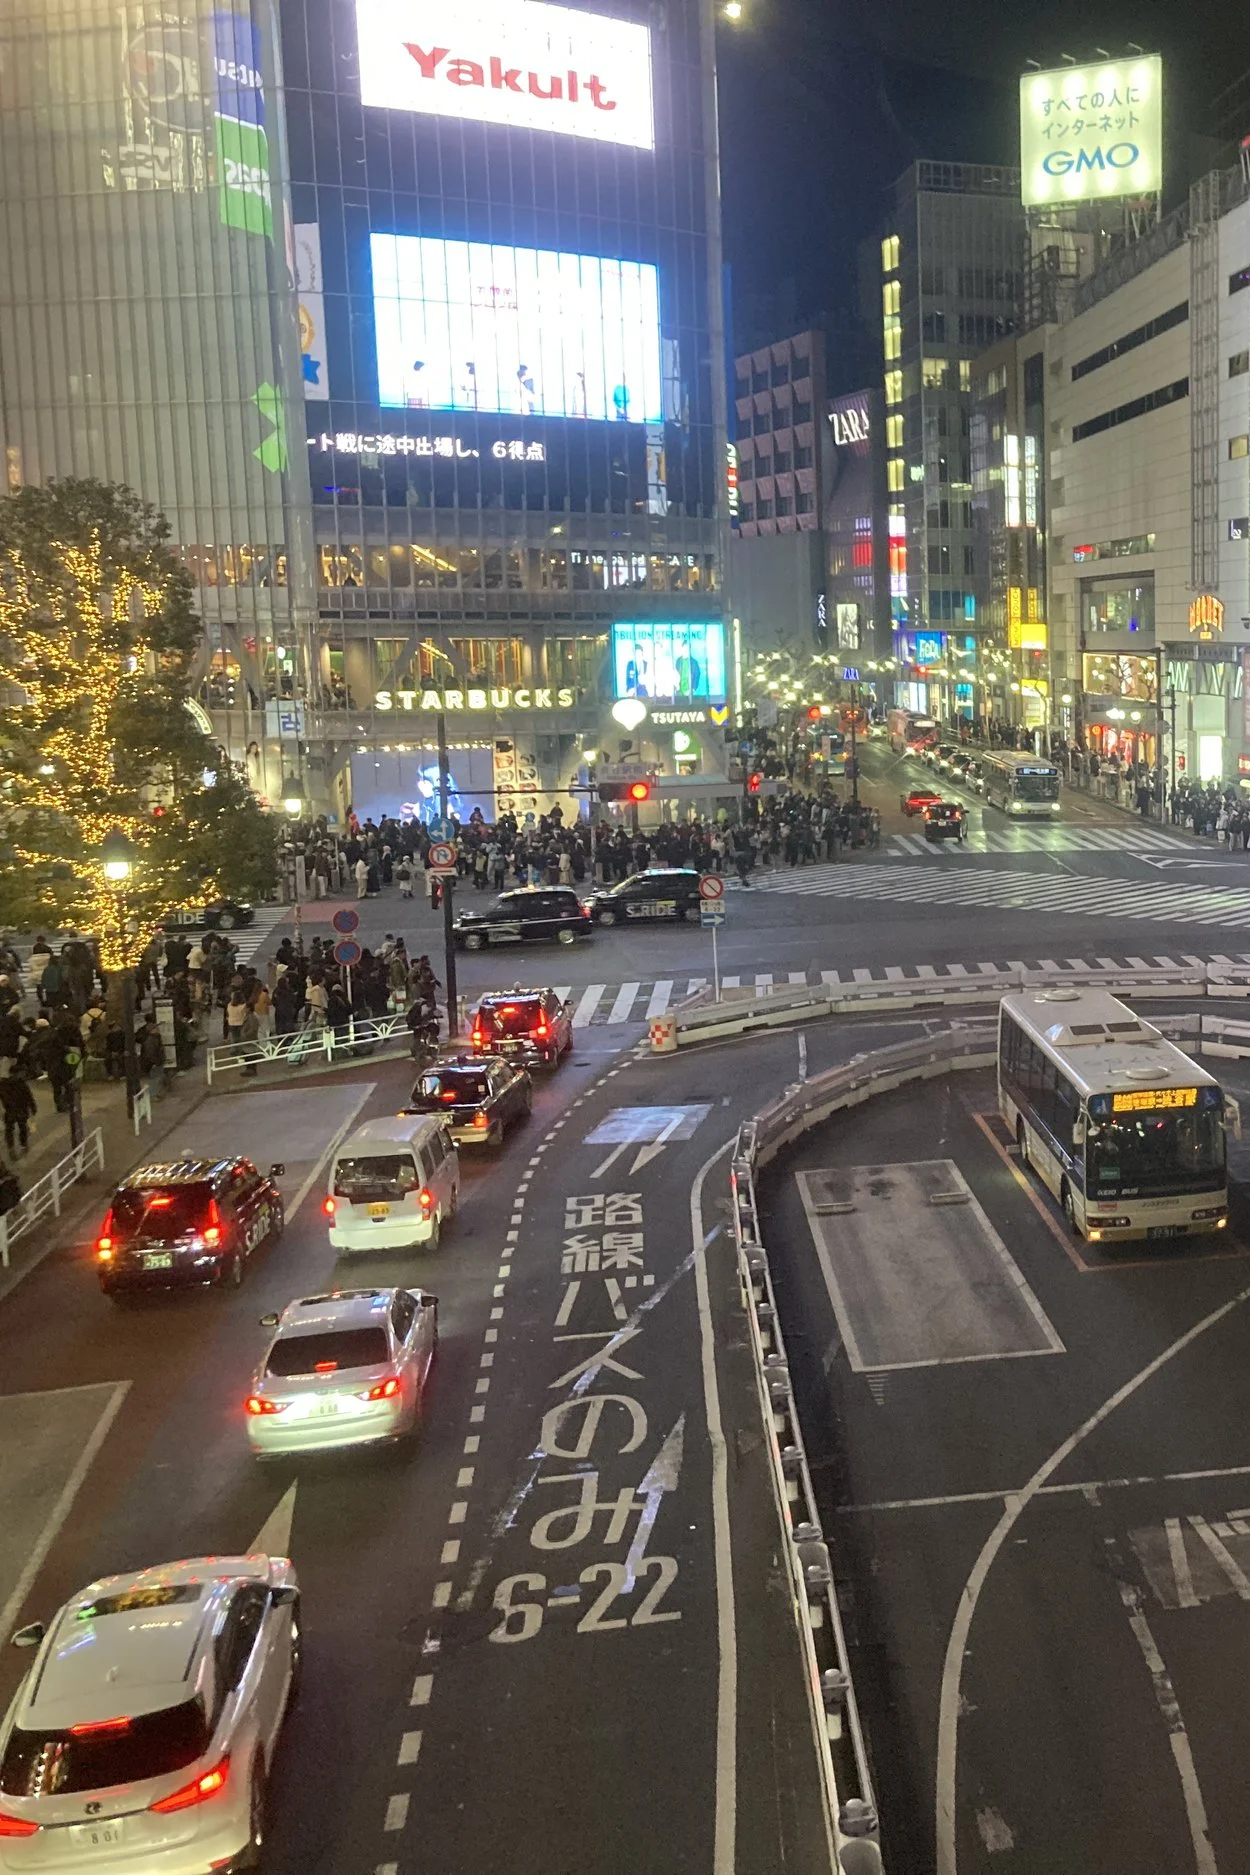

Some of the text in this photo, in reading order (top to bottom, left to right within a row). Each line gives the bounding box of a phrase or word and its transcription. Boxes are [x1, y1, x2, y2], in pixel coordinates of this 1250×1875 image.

[402, 42, 617, 110] Yakult
[1042, 87, 1140, 116] すべての人に
[1042, 111, 1140, 140] インターネット
[1042, 142, 1140, 176] GMO
[828, 408, 870, 446] ZARA
[818, 595, 827, 627] ZARA
[843, 667, 859, 680] ZARA
[375, 688, 574, 711] STARBUCKS
[651, 711, 706, 724] TSUTAYA
[1097, 1187, 1139, 1196] KEIO BUS
[530, 1192, 655, 1550] 路線バスのみ
[489, 1555, 682, 1644] 6-22
